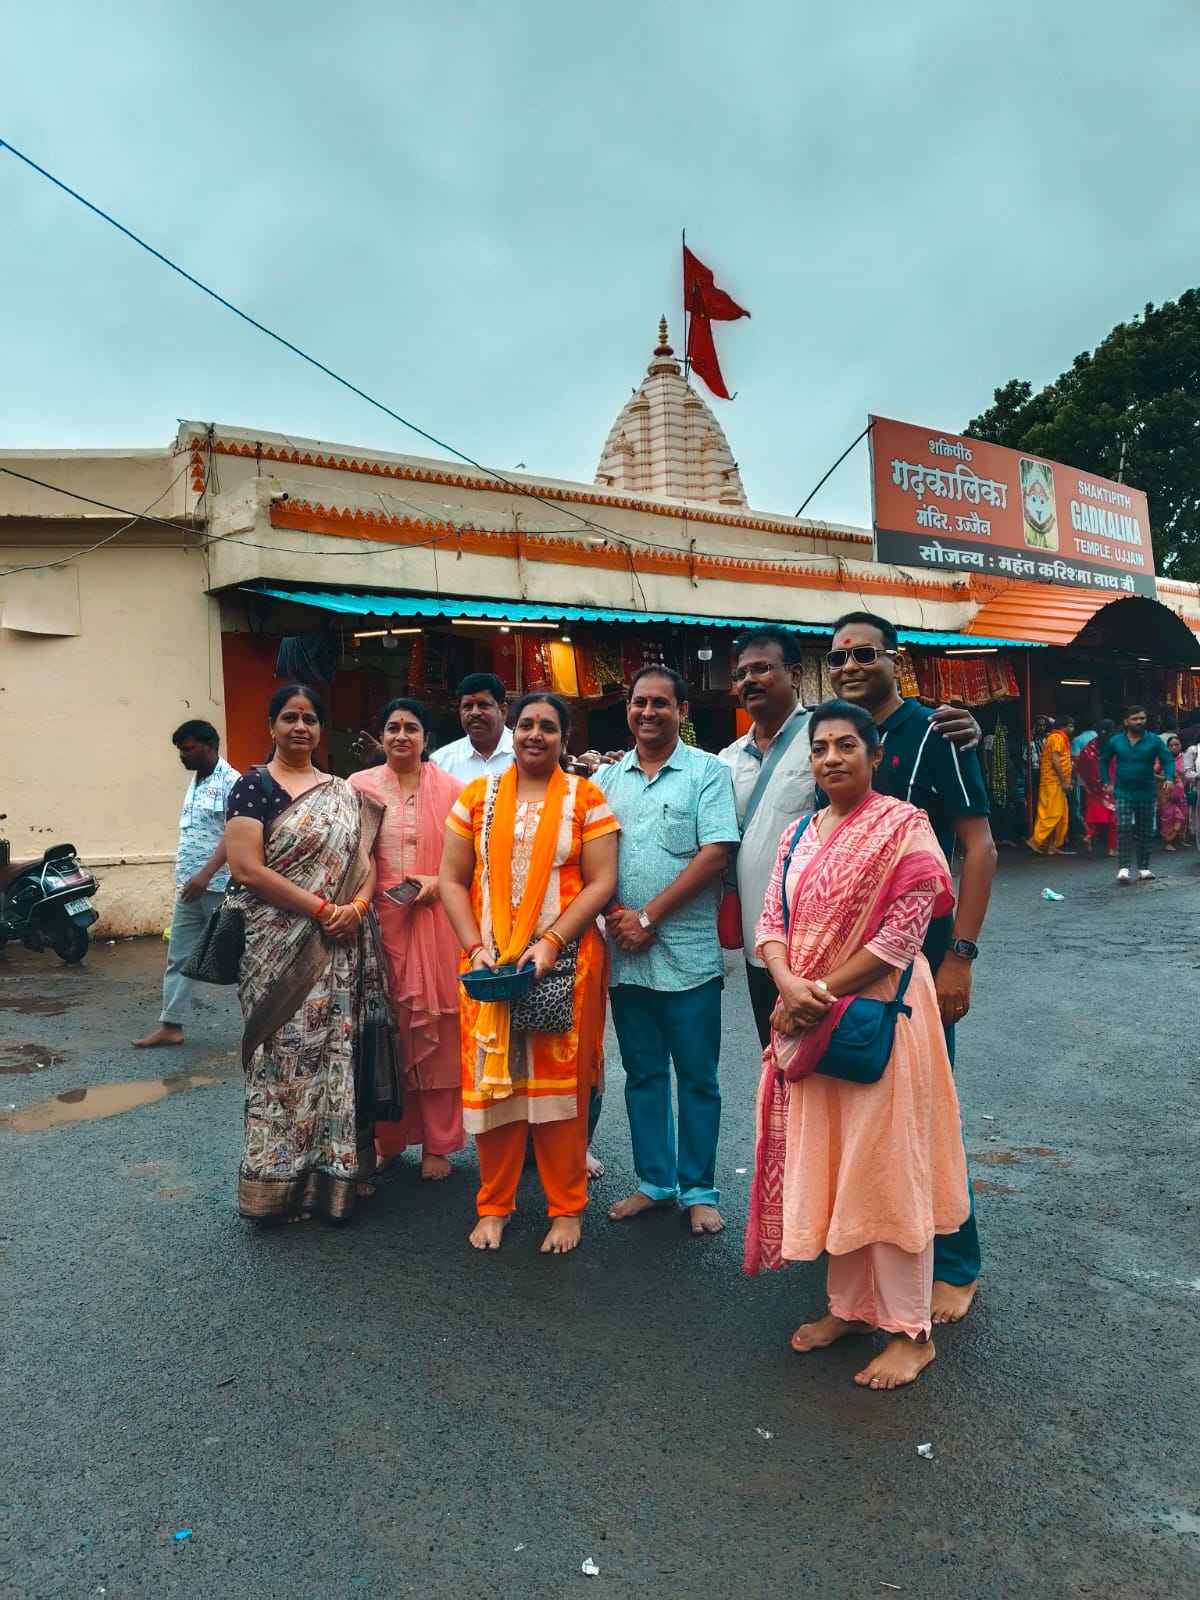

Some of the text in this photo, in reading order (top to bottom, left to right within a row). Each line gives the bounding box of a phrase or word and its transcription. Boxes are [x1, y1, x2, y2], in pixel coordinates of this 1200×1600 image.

[928, 438, 973, 461] शक्तिपीठ
[891, 459, 1008, 509] गढ़कालिका
[1078, 480, 1131, 509] SHAKTIPITH
[916, 503, 992, 536] मंदिर, उज्जैन
[1070, 500, 1142, 546] GADKALIKA
[1074, 537, 1145, 567] TEMPLE, UJJAIN
[997, 552, 1035, 575] महंत
[1093, 572, 1119, 589] नाथ
[1120, 575, 1135, 592] जी
